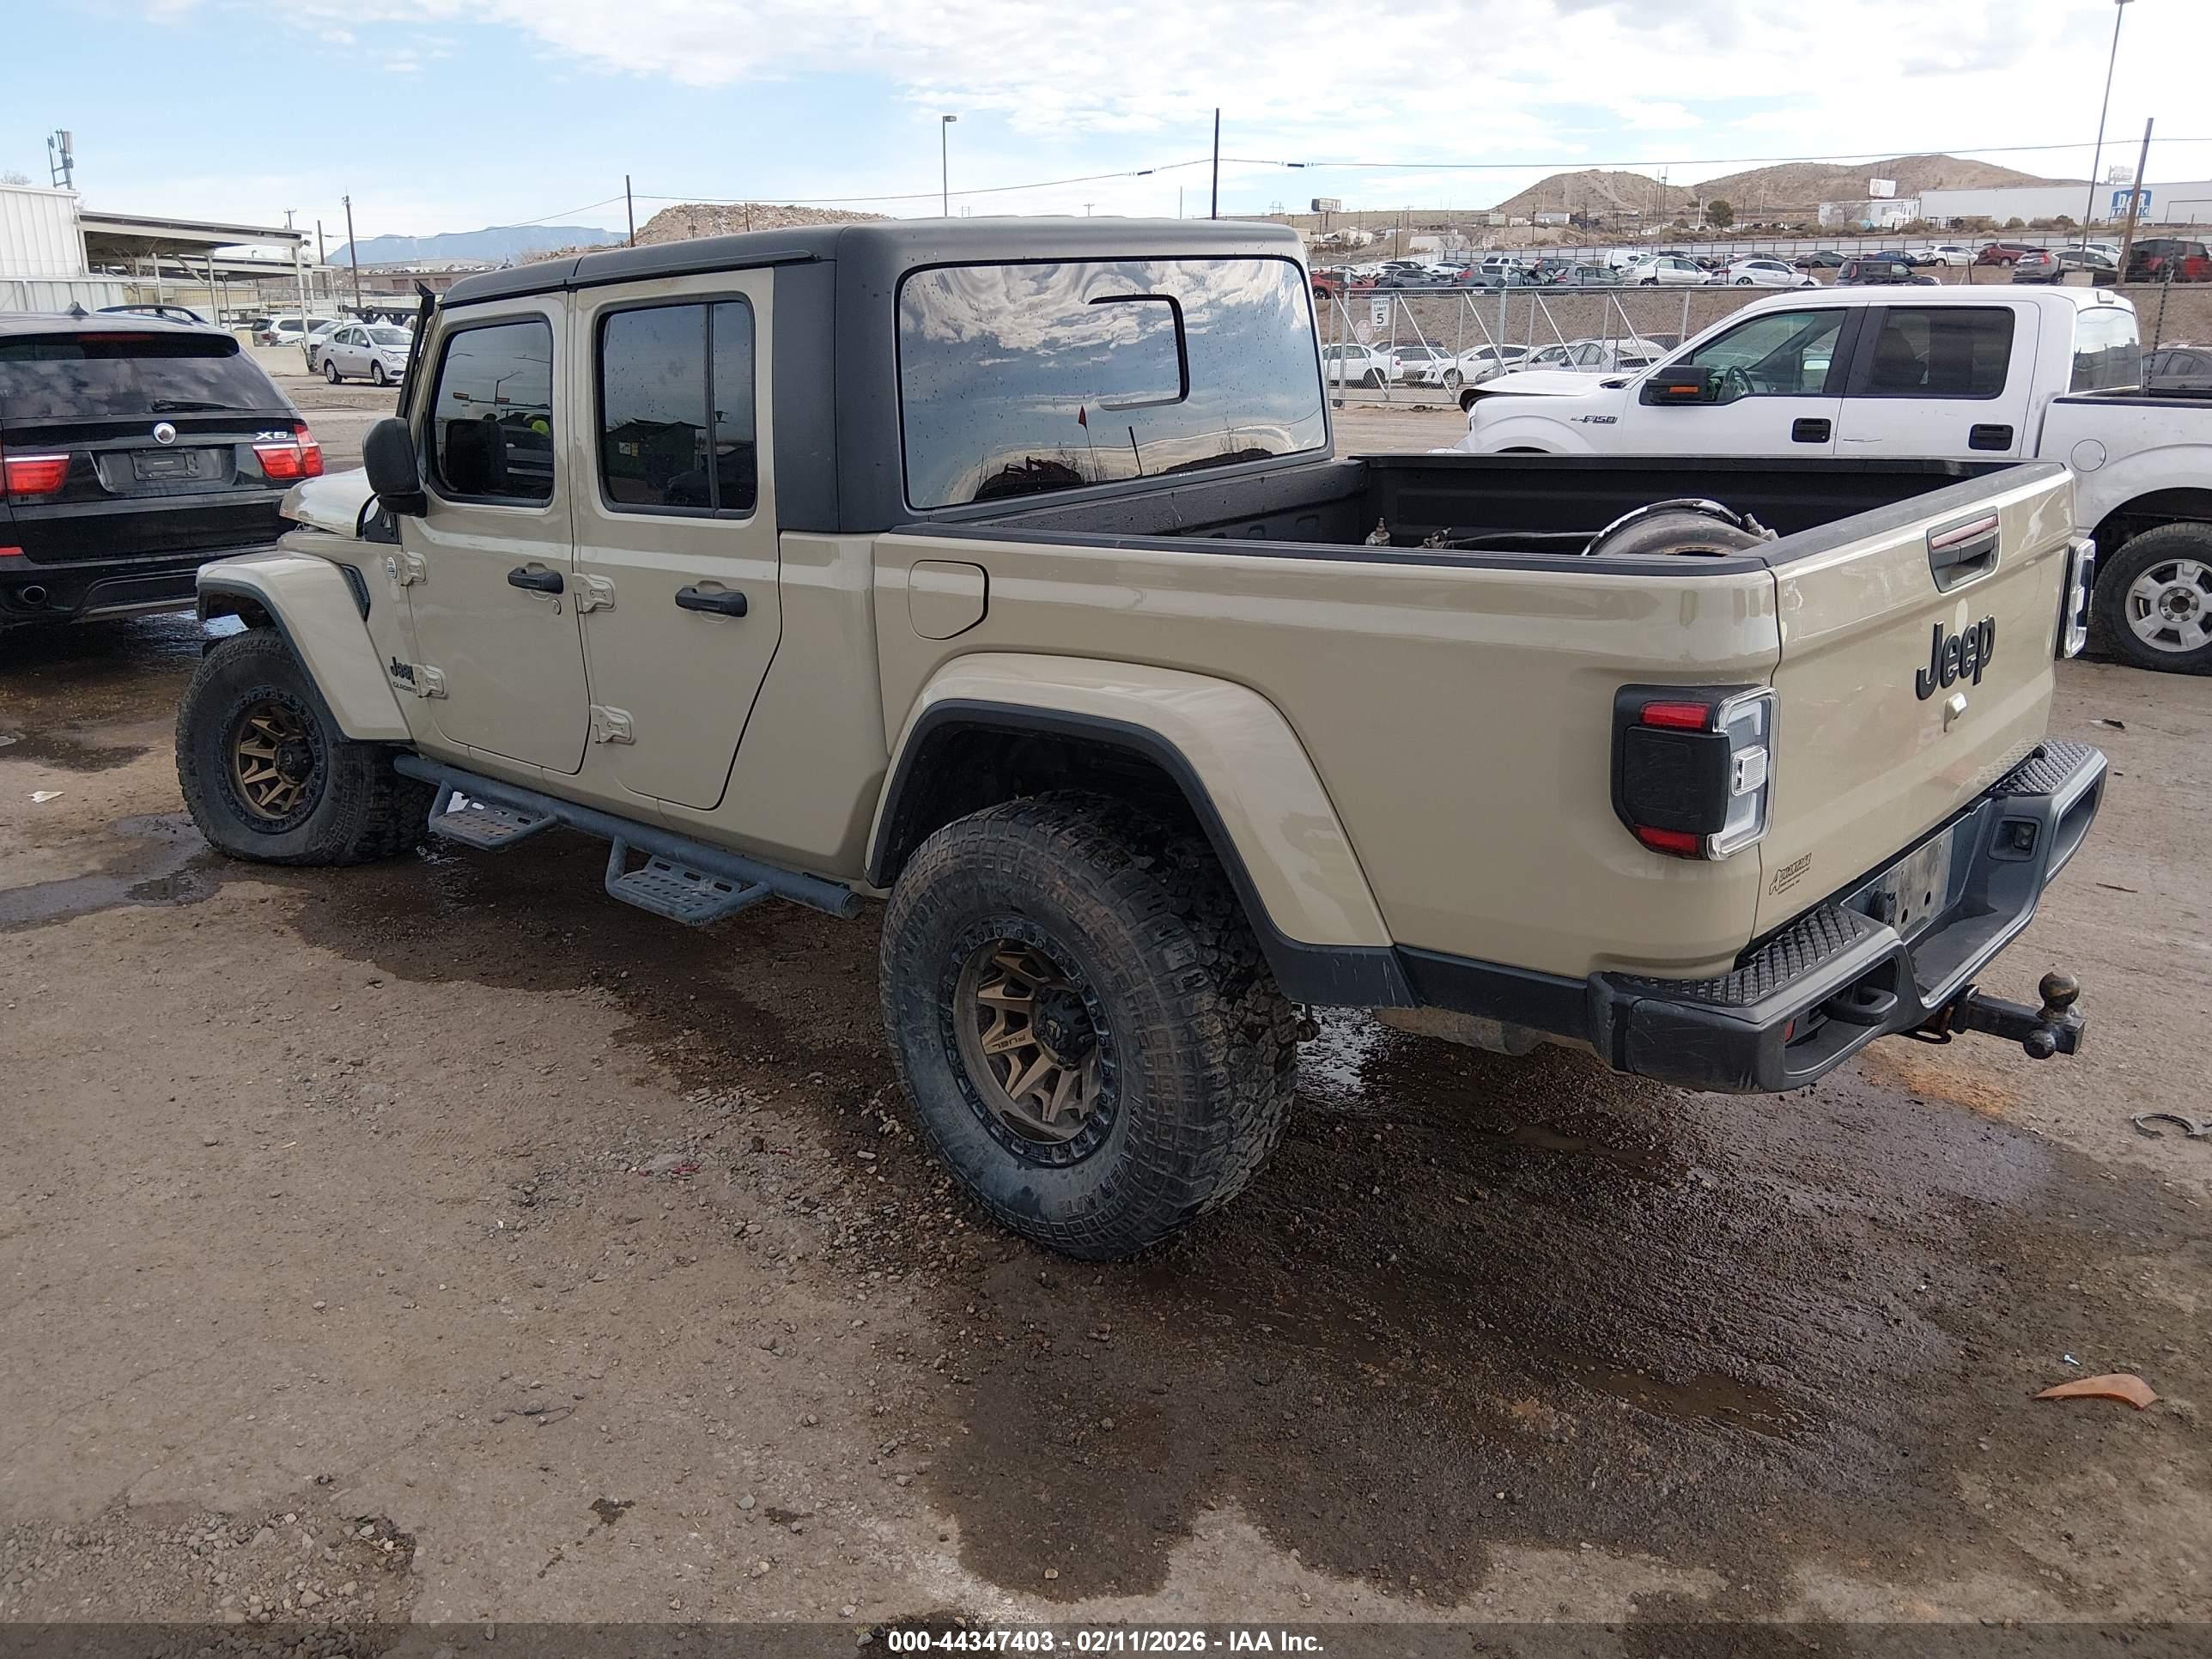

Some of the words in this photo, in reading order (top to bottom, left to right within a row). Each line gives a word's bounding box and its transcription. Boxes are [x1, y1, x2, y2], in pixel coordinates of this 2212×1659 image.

[2112, 207, 2148, 217] TAK
[1376, 313, 1384, 324] 5
[255, 431, 288, 441] X5
[1916, 614, 1996, 701] Jeep
[992, 1035, 1026, 1048] FUEL
